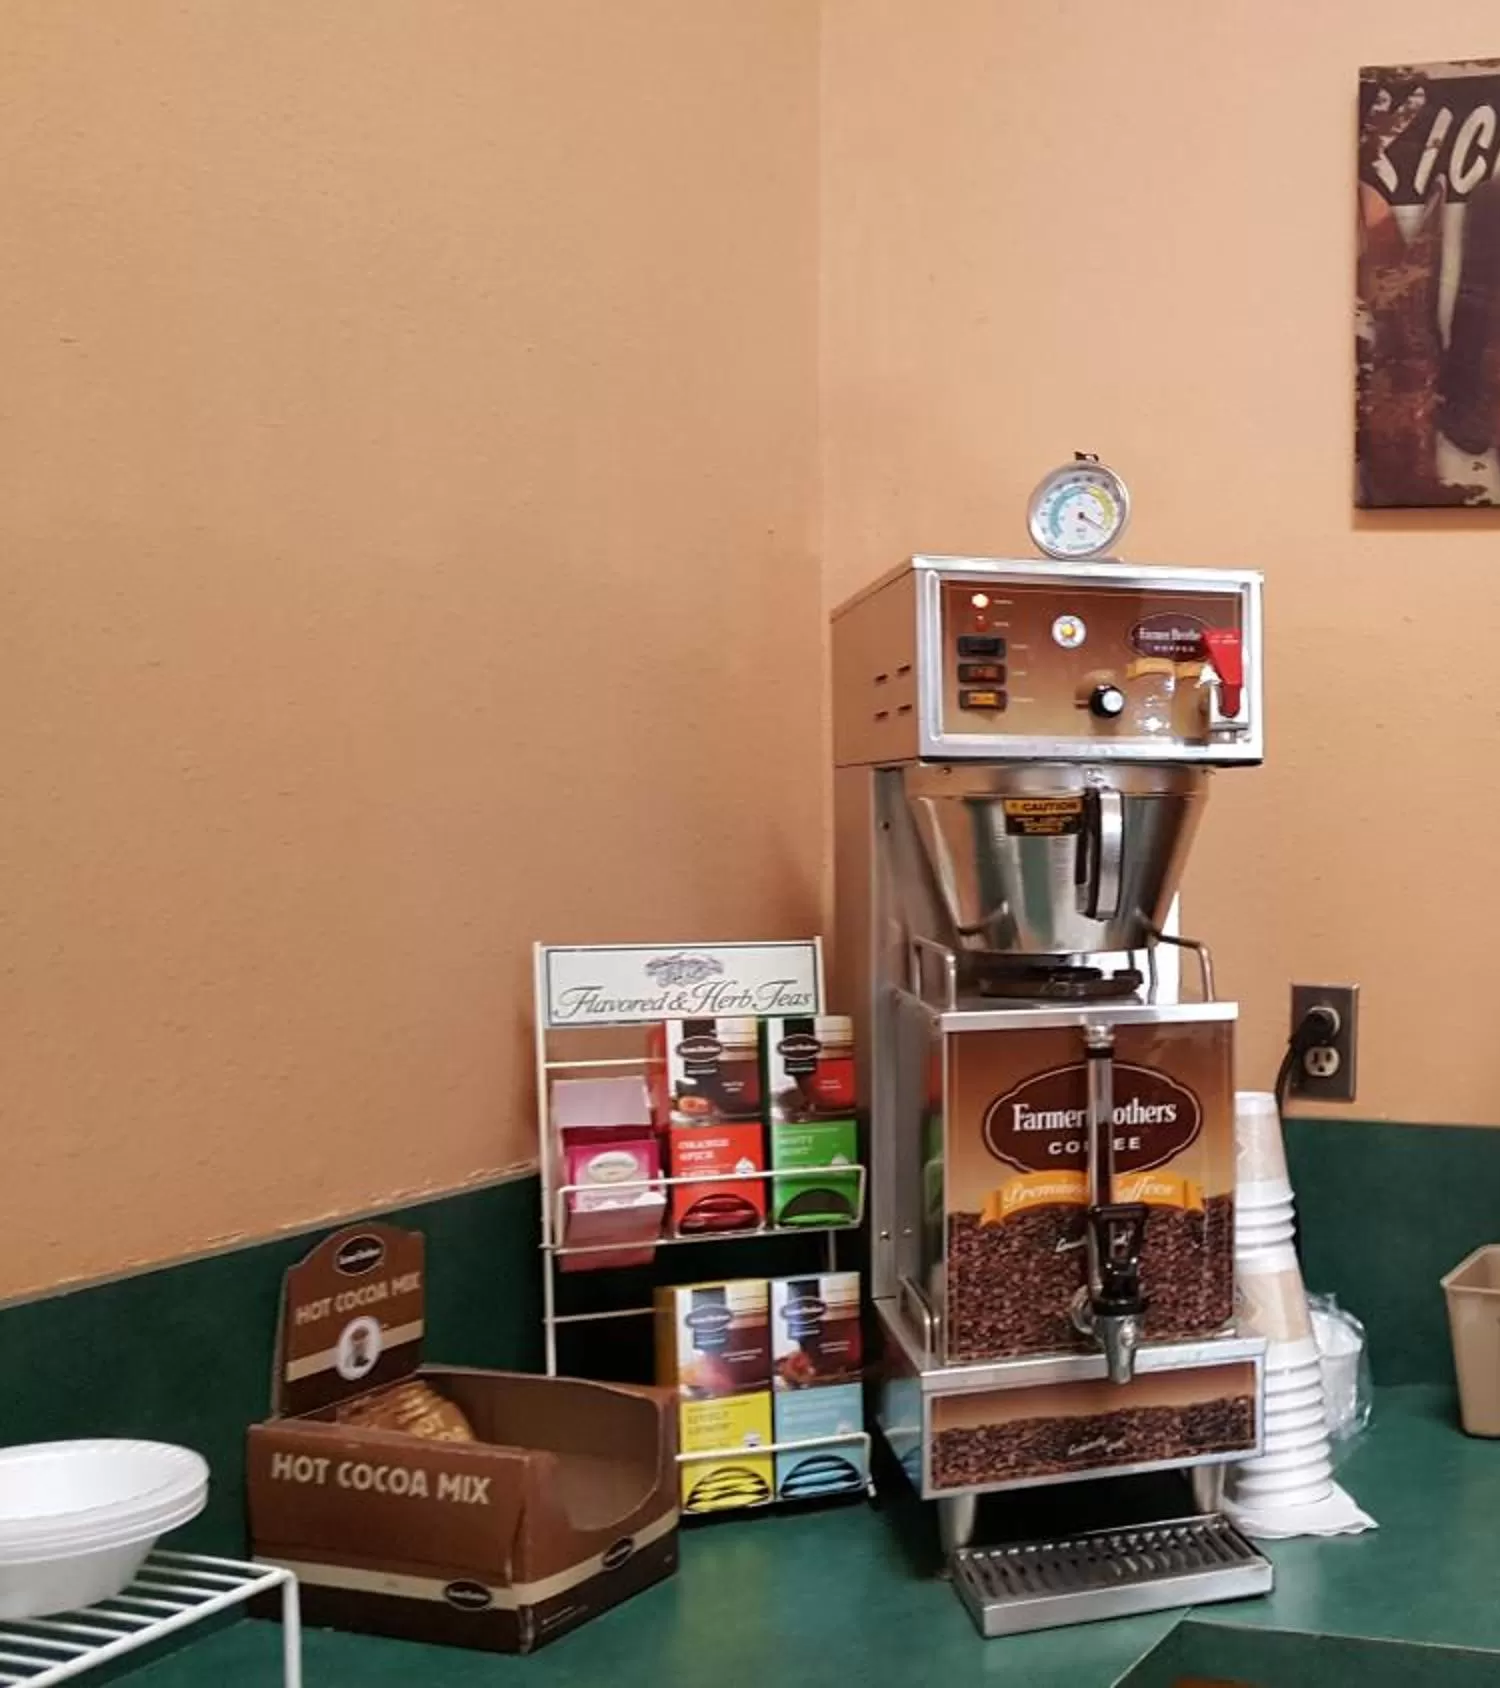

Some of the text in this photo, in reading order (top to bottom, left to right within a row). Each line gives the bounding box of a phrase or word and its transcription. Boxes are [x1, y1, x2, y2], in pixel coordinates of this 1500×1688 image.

[1022, 800, 1078, 812] CAUTION
[553, 979, 812, 1019] Flavored & Herb Teas
[1012, 1097, 1177, 1132] Farmer others
[1048, 1136, 1142, 1156] COEE
[295, 1270, 421, 1326] HOT COCOA MIX
[272, 1452, 492, 1505] HOT COCOA MIX
